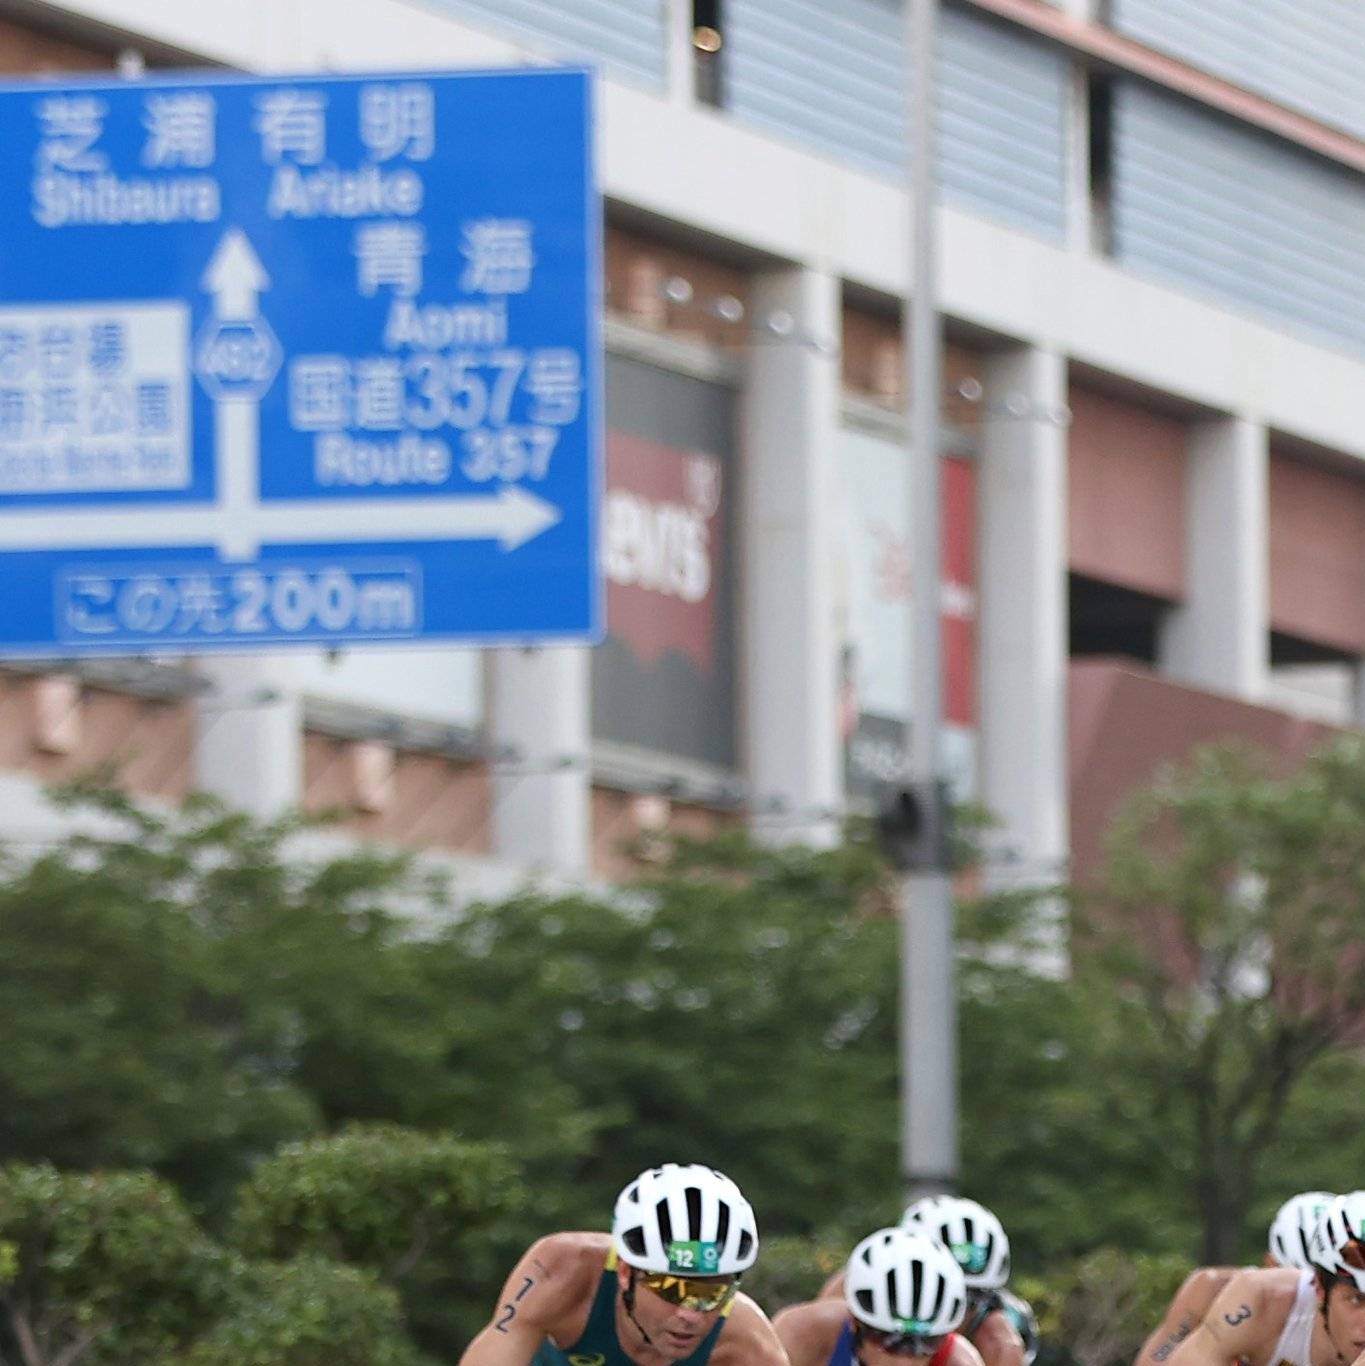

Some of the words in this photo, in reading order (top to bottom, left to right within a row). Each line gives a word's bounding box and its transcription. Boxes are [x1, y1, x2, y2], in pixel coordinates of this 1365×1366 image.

[35, 90, 215, 171] 芝浦
[253, 82, 436, 166] 有明
[32, 174, 221, 227] Shibaura
[267, 165, 425, 220] Ariake
[354, 218, 534, 296] 青海
[384, 302, 509, 351] Aomi
[289, 347, 583, 431] 国道357号
[314, 432, 452, 486] Route
[459, 425, 560, 481] 357
[63, 564, 417, 636] この先200m
[674, 1249, 695, 1269] 12
[1223, 1304, 1252, 1328] 3
